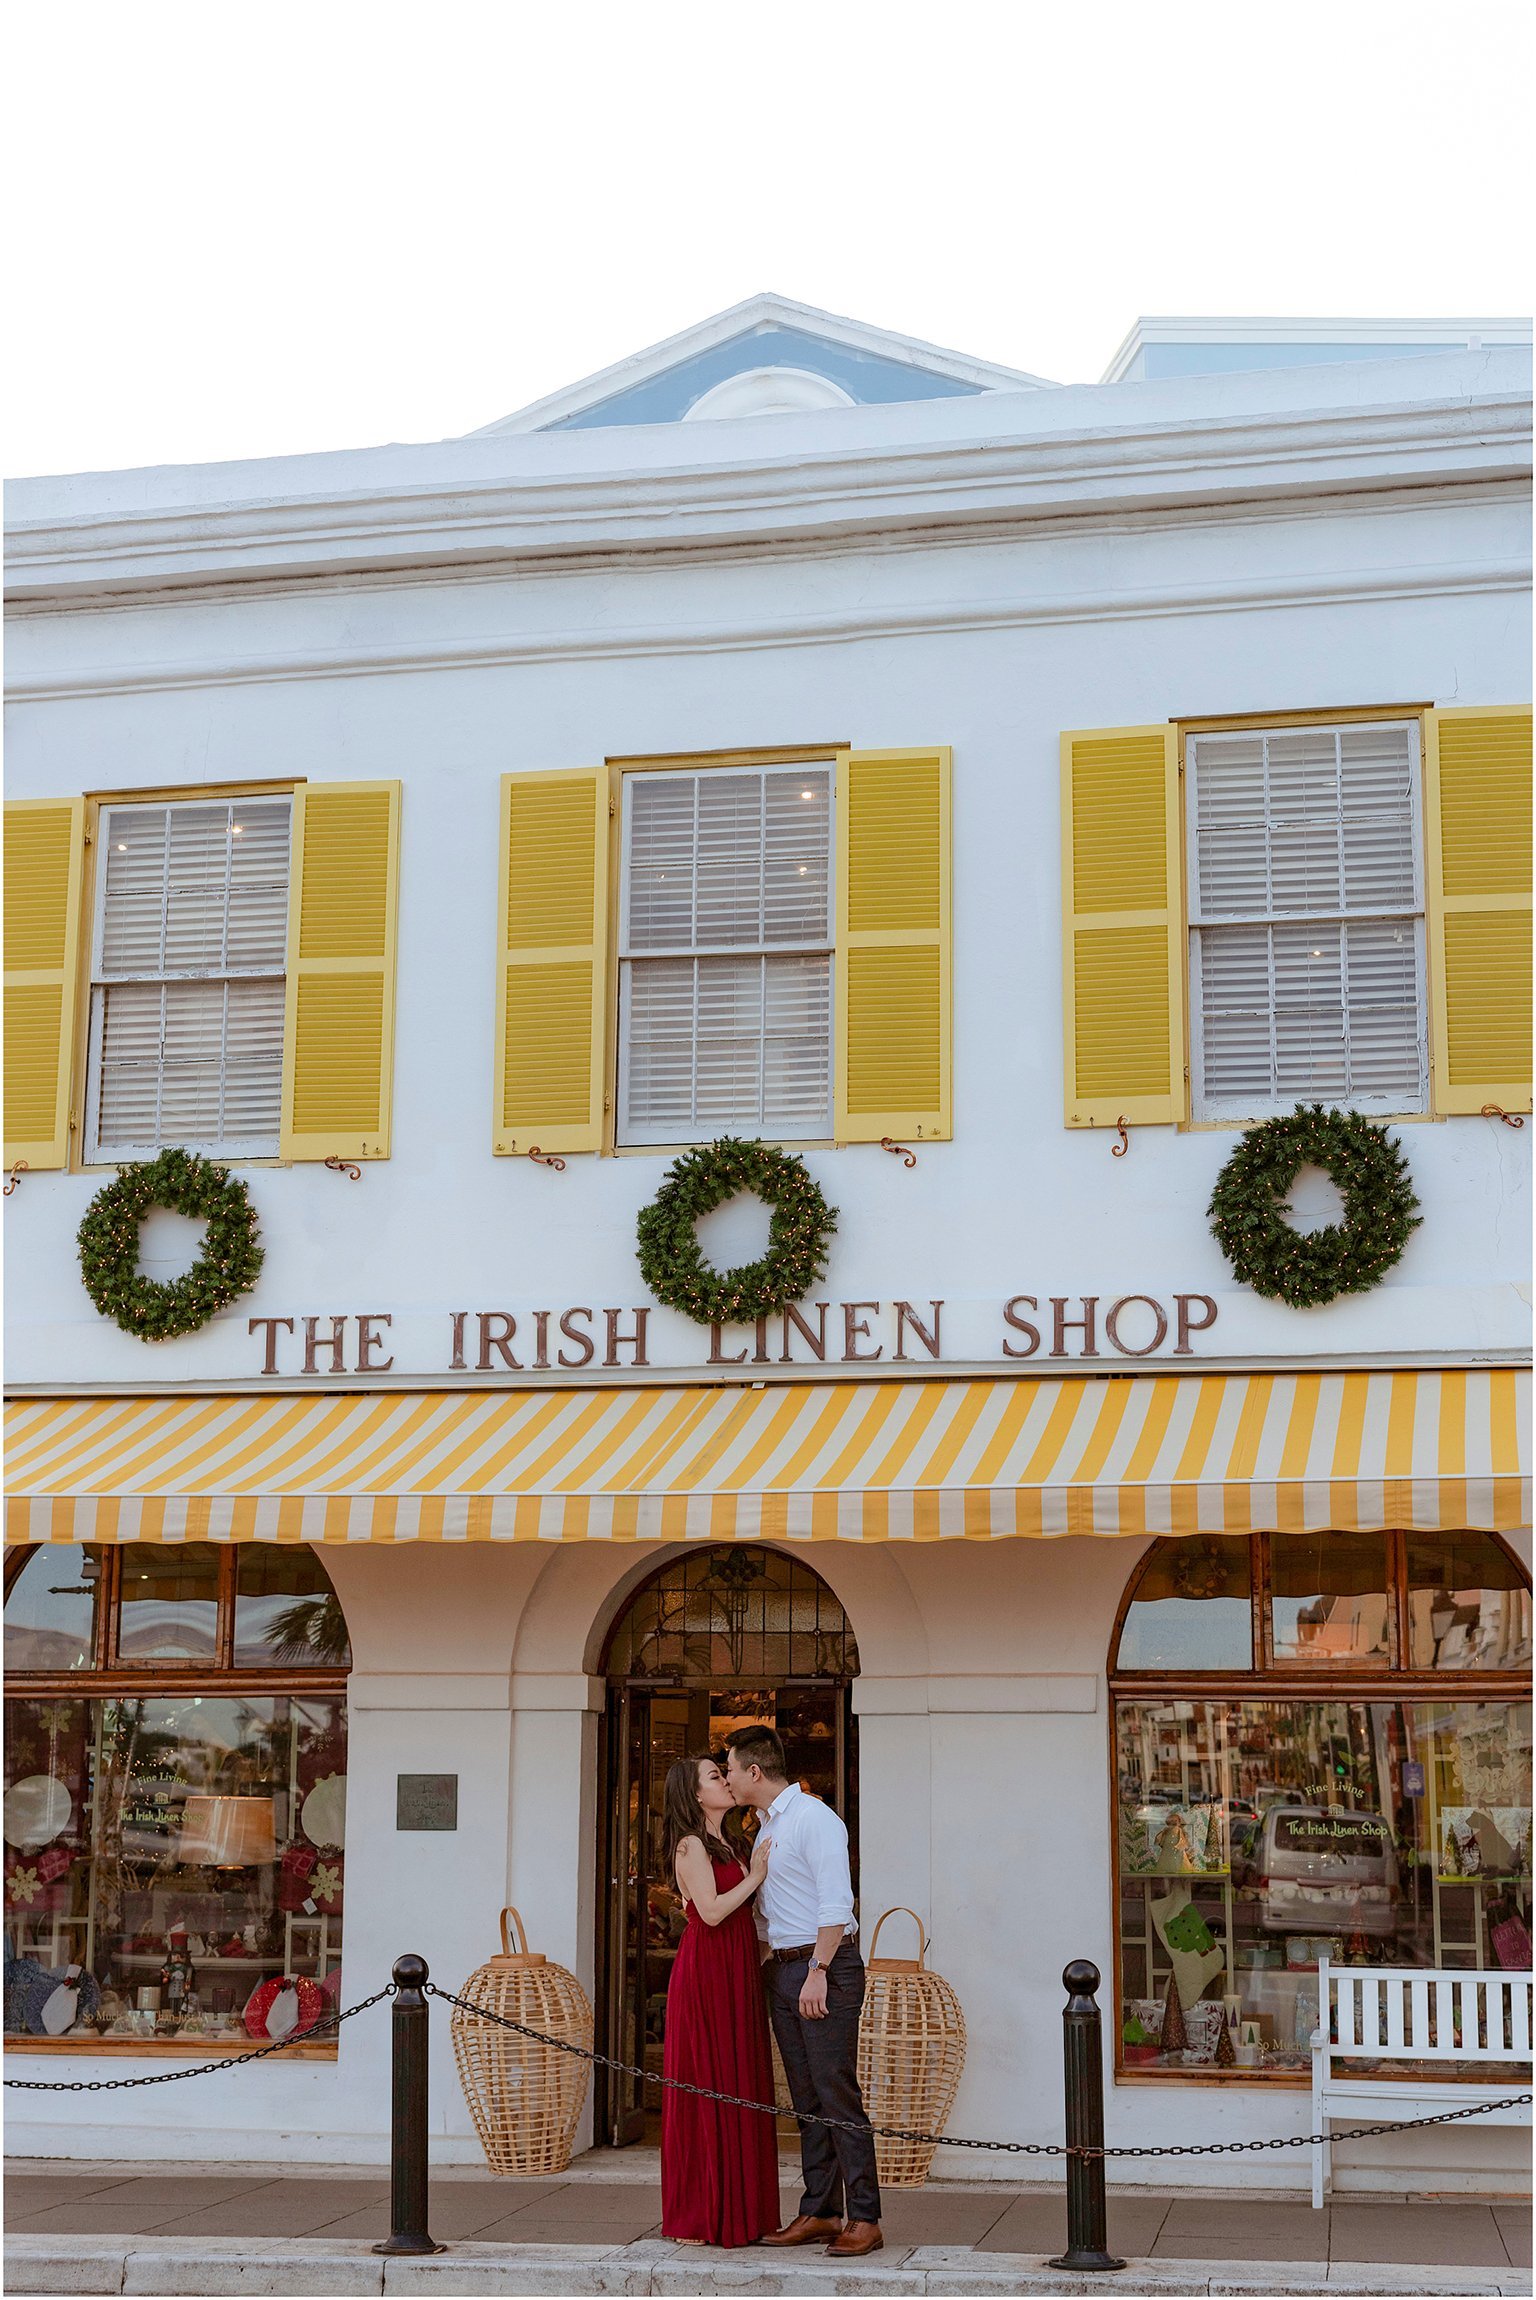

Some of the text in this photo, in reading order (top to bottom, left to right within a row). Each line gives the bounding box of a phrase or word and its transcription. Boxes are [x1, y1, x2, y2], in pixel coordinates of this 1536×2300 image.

[248, 1294, 1219, 1375] THE IRISH LINEN SHOP
[136, 1772, 188, 1787] Fine Living
[1304, 1781, 1365, 1799] Fine Living
[118, 1807, 134, 1821] The
[135, 1808, 154, 1821] Irish
[154, 1808, 180, 1824] Linen
[1285, 1820, 1388, 1840] The Irish Linen Shop
[1272, 2038, 1303, 2051] Much
